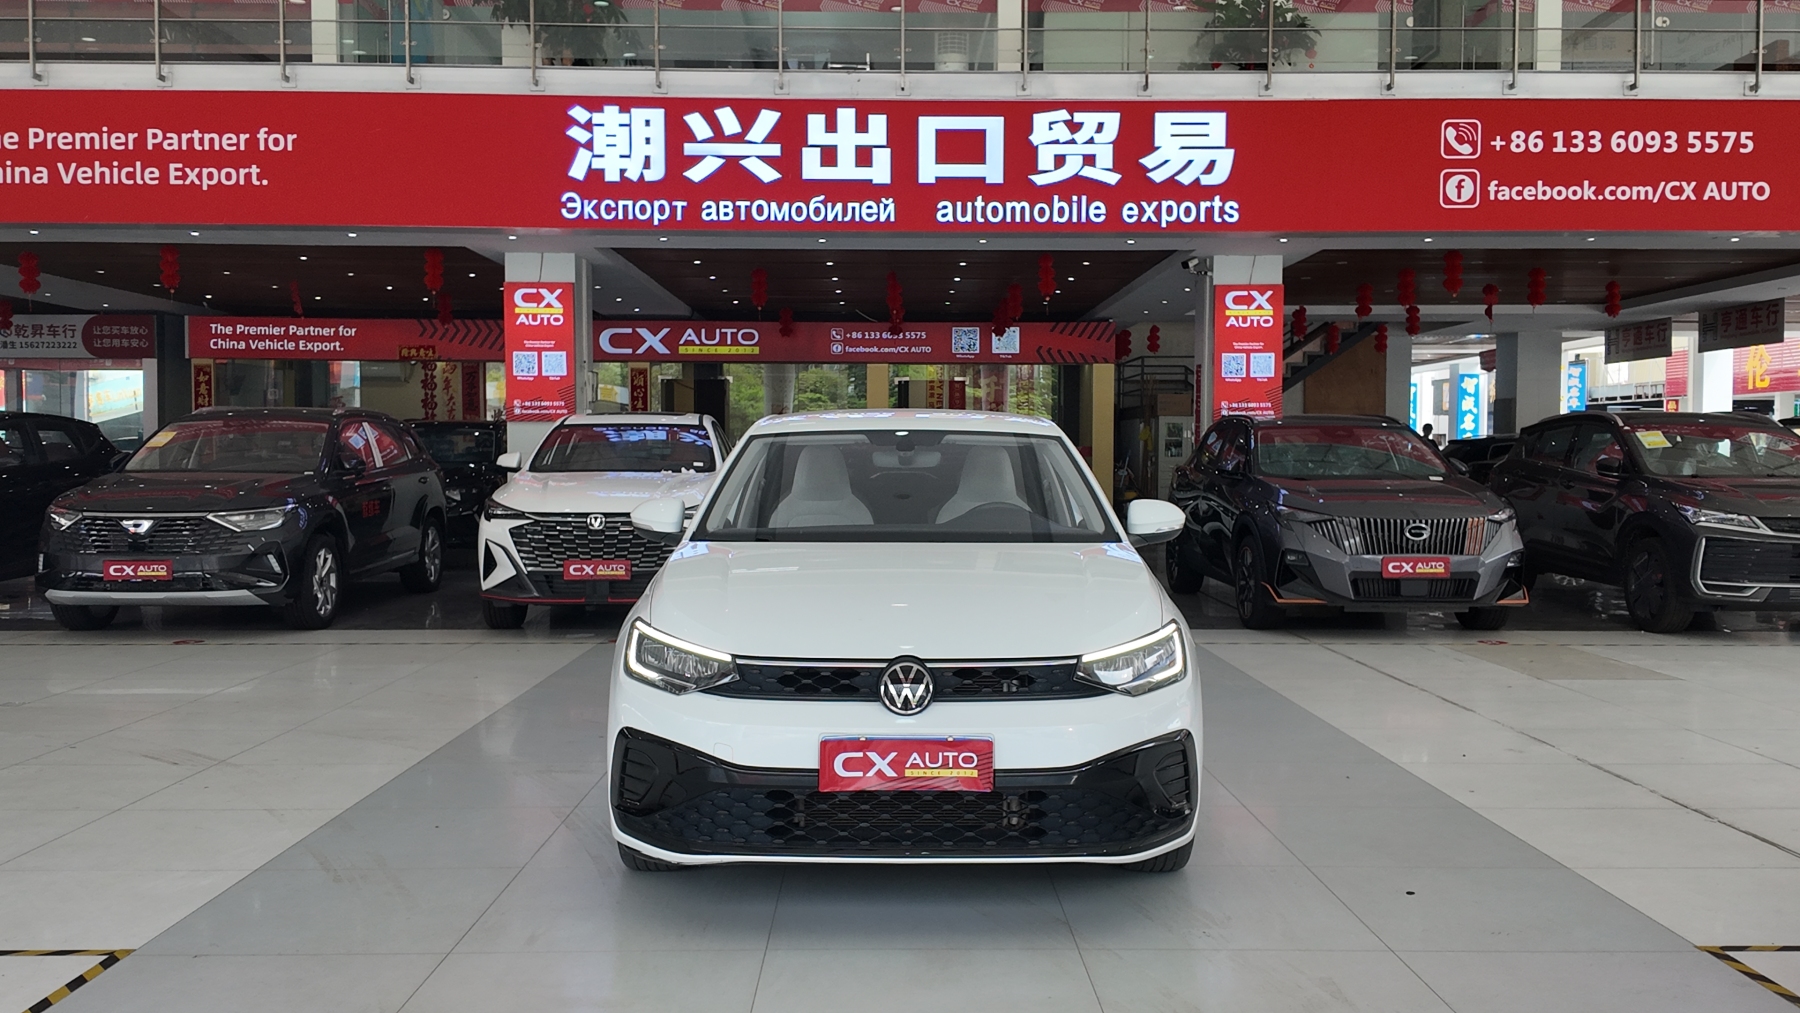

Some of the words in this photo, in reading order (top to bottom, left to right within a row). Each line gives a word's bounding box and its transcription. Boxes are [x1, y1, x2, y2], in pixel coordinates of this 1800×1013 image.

[28, 126, 139, 151] Premier
[146, 128, 250, 151] Partner
[256, 127, 298, 152] for
[565, 103, 1236, 186] 潮兴出口贸易
[1490, 130, 1544, 154] +86
[1552, 130, 1602, 154] 133
[1610, 130, 1678, 154] 6093
[1687, 131, 1755, 154] 5575
[56, 160, 160, 185] Vehicle
[168, 163, 269, 191] Export.
[1487, 180, 1697, 204] facebook.com/CX
[1703, 181, 1771, 201] AUTO
[560, 191, 688, 226] Экспорт
[701, 193, 896, 223] автомобилей
[936, 194, 1107, 224] automobile
[1122, 194, 1240, 228] exports
[513, 288, 564, 308] CX
[1225, 290, 1274, 310] CX
[515, 314, 564, 326] AUTO
[1225, 316, 1274, 328] AUTO
[1720, 303, 1780, 334] 亨通车行
[92, 326, 148, 335] 让您买车放心
[209, 323, 233, 336] The
[236, 324, 286, 336] Premier
[289, 325, 336, 337] Partner
[338, 325, 357, 337] for
[845, 331, 863, 339] +86
[864, 331, 881, 339] 133
[905, 331, 927, 340] 5575
[92, 338, 148, 348] 让您用车安心
[209, 338, 246, 351] China
[249, 338, 296, 352] Vehicle
[298, 340, 345, 353] Export.
[598, 327, 671, 354] CX
[678, 328, 760, 345] AUTO
[910, 346, 932, 354] AUTO
[109, 564, 136, 576] CX
[137, 564, 168, 572] AUTO
[569, 564, 595, 576] CX
[597, 564, 626, 572] AUTO
[1387, 561, 1414, 573] CX
[1416, 561, 1445, 569] AUTO
[833, 751, 899, 778] CX
[904, 751, 979, 768] AUTO
